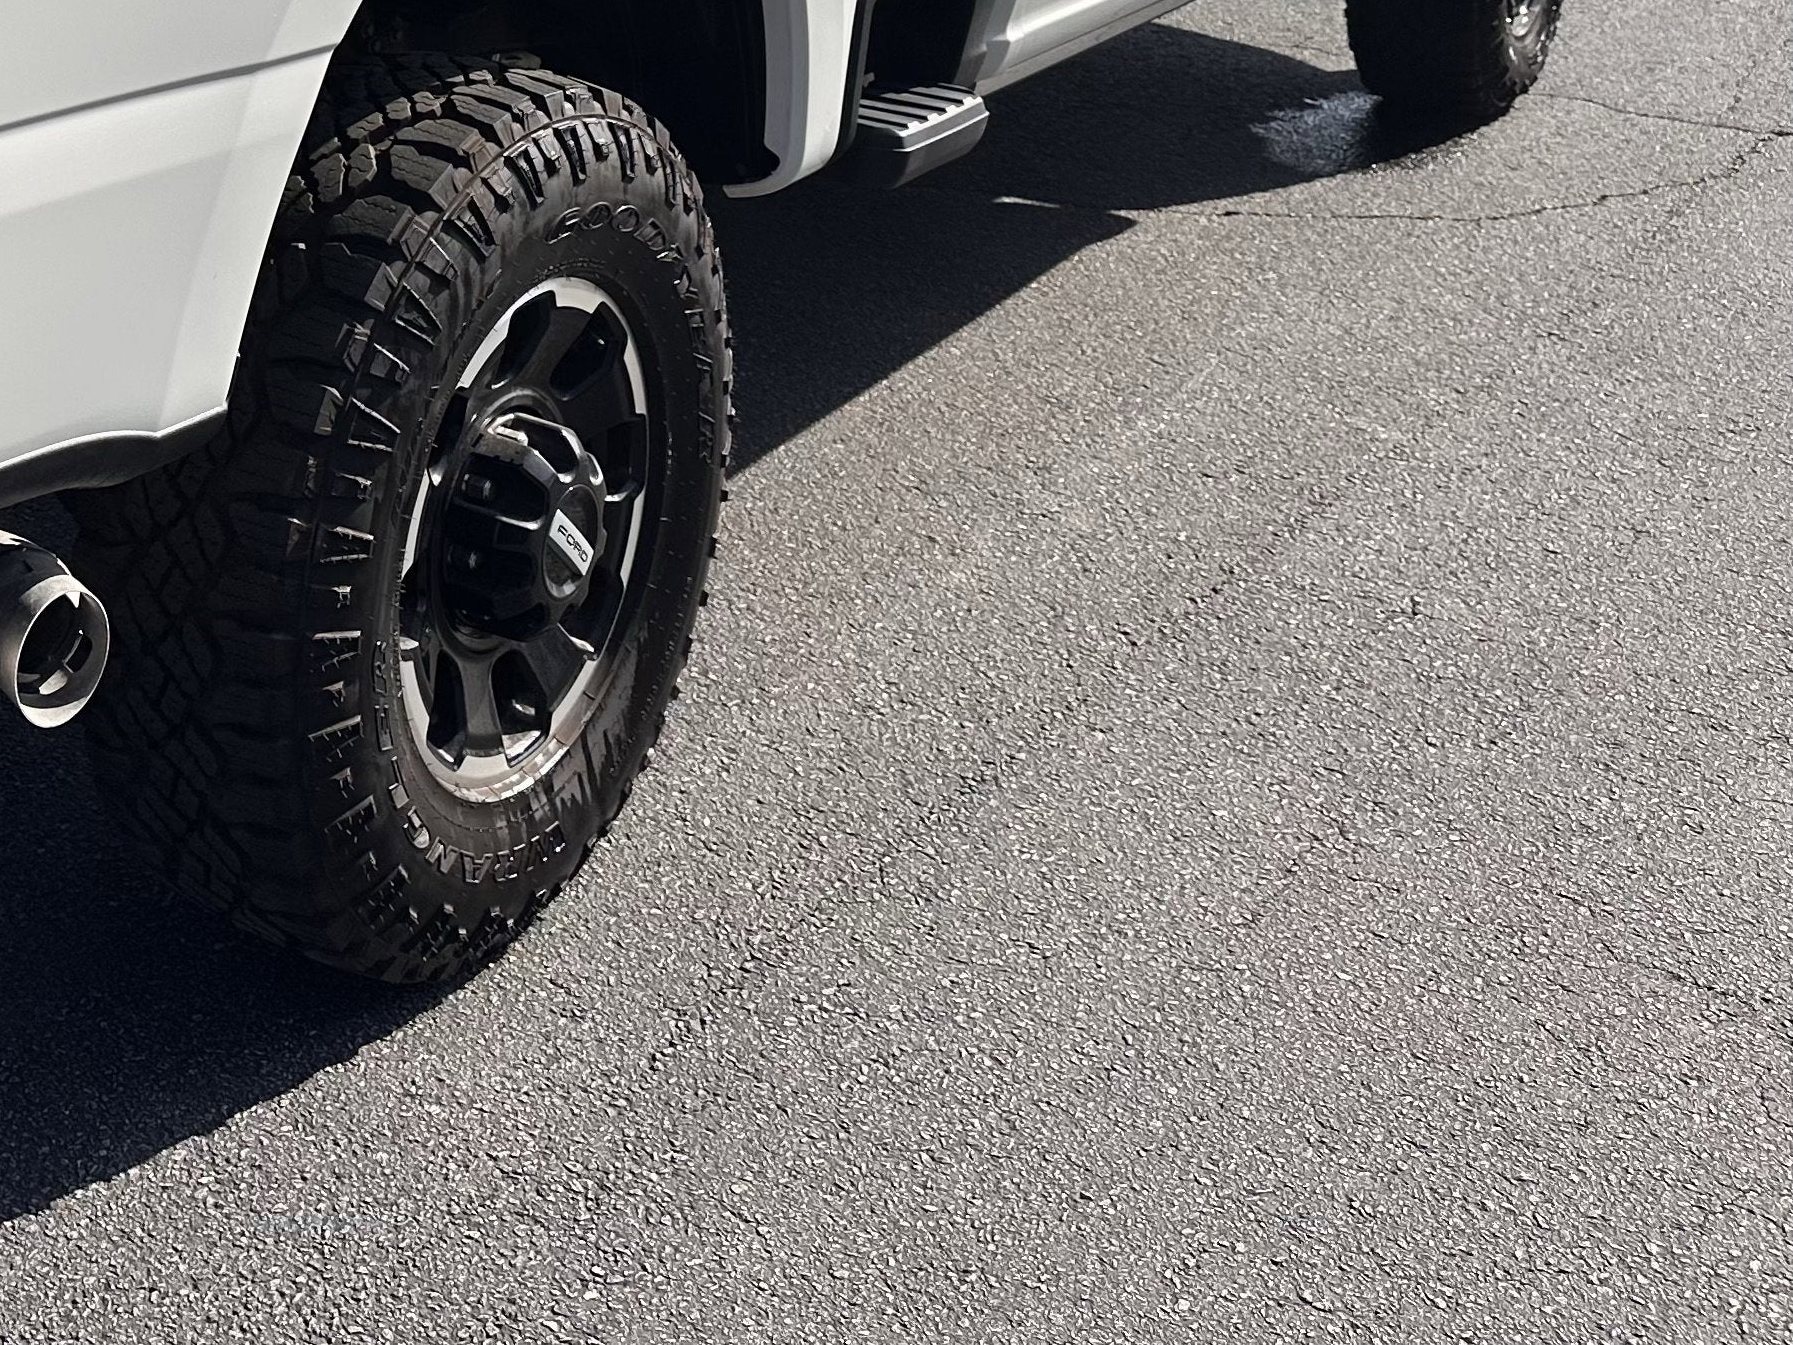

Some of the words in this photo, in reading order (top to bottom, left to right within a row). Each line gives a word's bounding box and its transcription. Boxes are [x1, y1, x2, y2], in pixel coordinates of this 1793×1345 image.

[544, 200, 717, 469] GOODYEAR
[556, 523, 589, 563] FORD
[372, 638, 567, 887] WRANGLER
